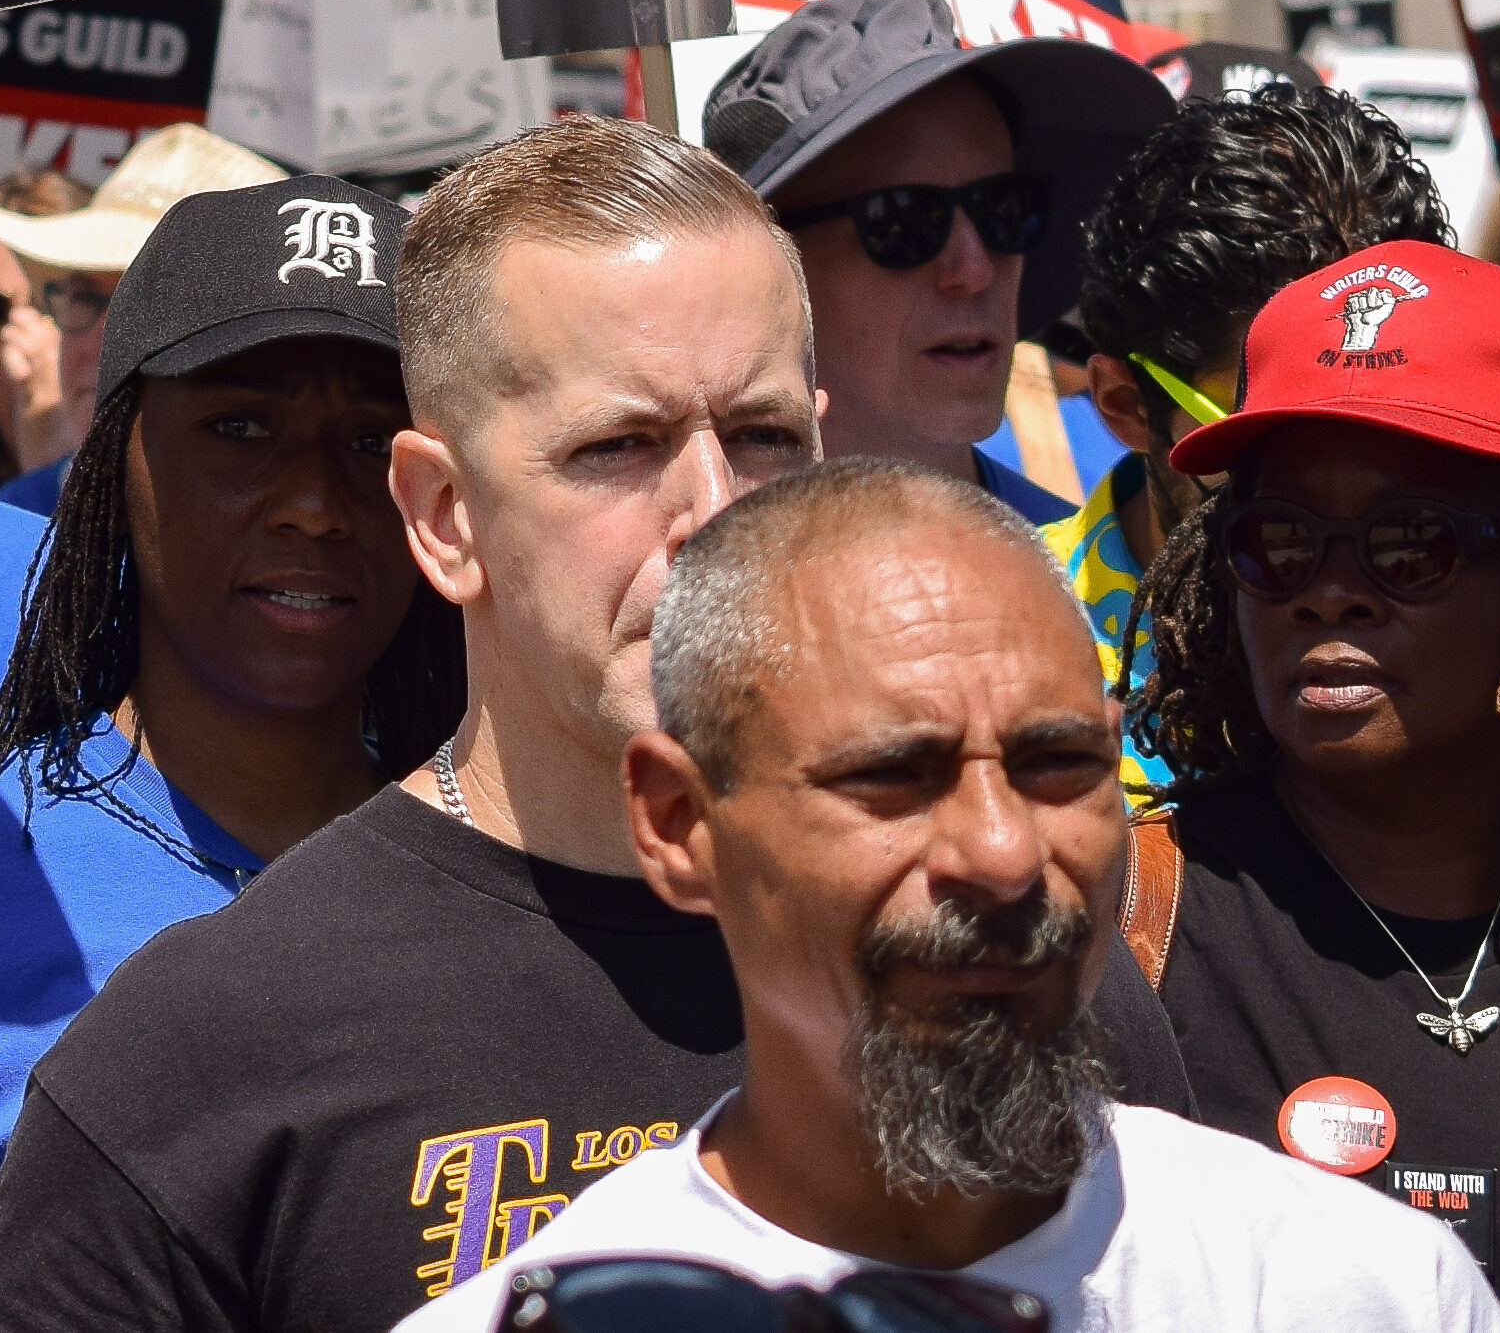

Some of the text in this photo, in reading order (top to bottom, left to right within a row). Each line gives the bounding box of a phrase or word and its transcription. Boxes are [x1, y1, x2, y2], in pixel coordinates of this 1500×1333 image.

[18, 9, 190, 78] GUILD
[1320, 264, 1431, 301] WRITERS GUILD
[571, 1122, 679, 1171] LOS
[1394, 1169, 1485, 1195] I STAND WITH
[1409, 1189, 1469, 1209] THE WGA
